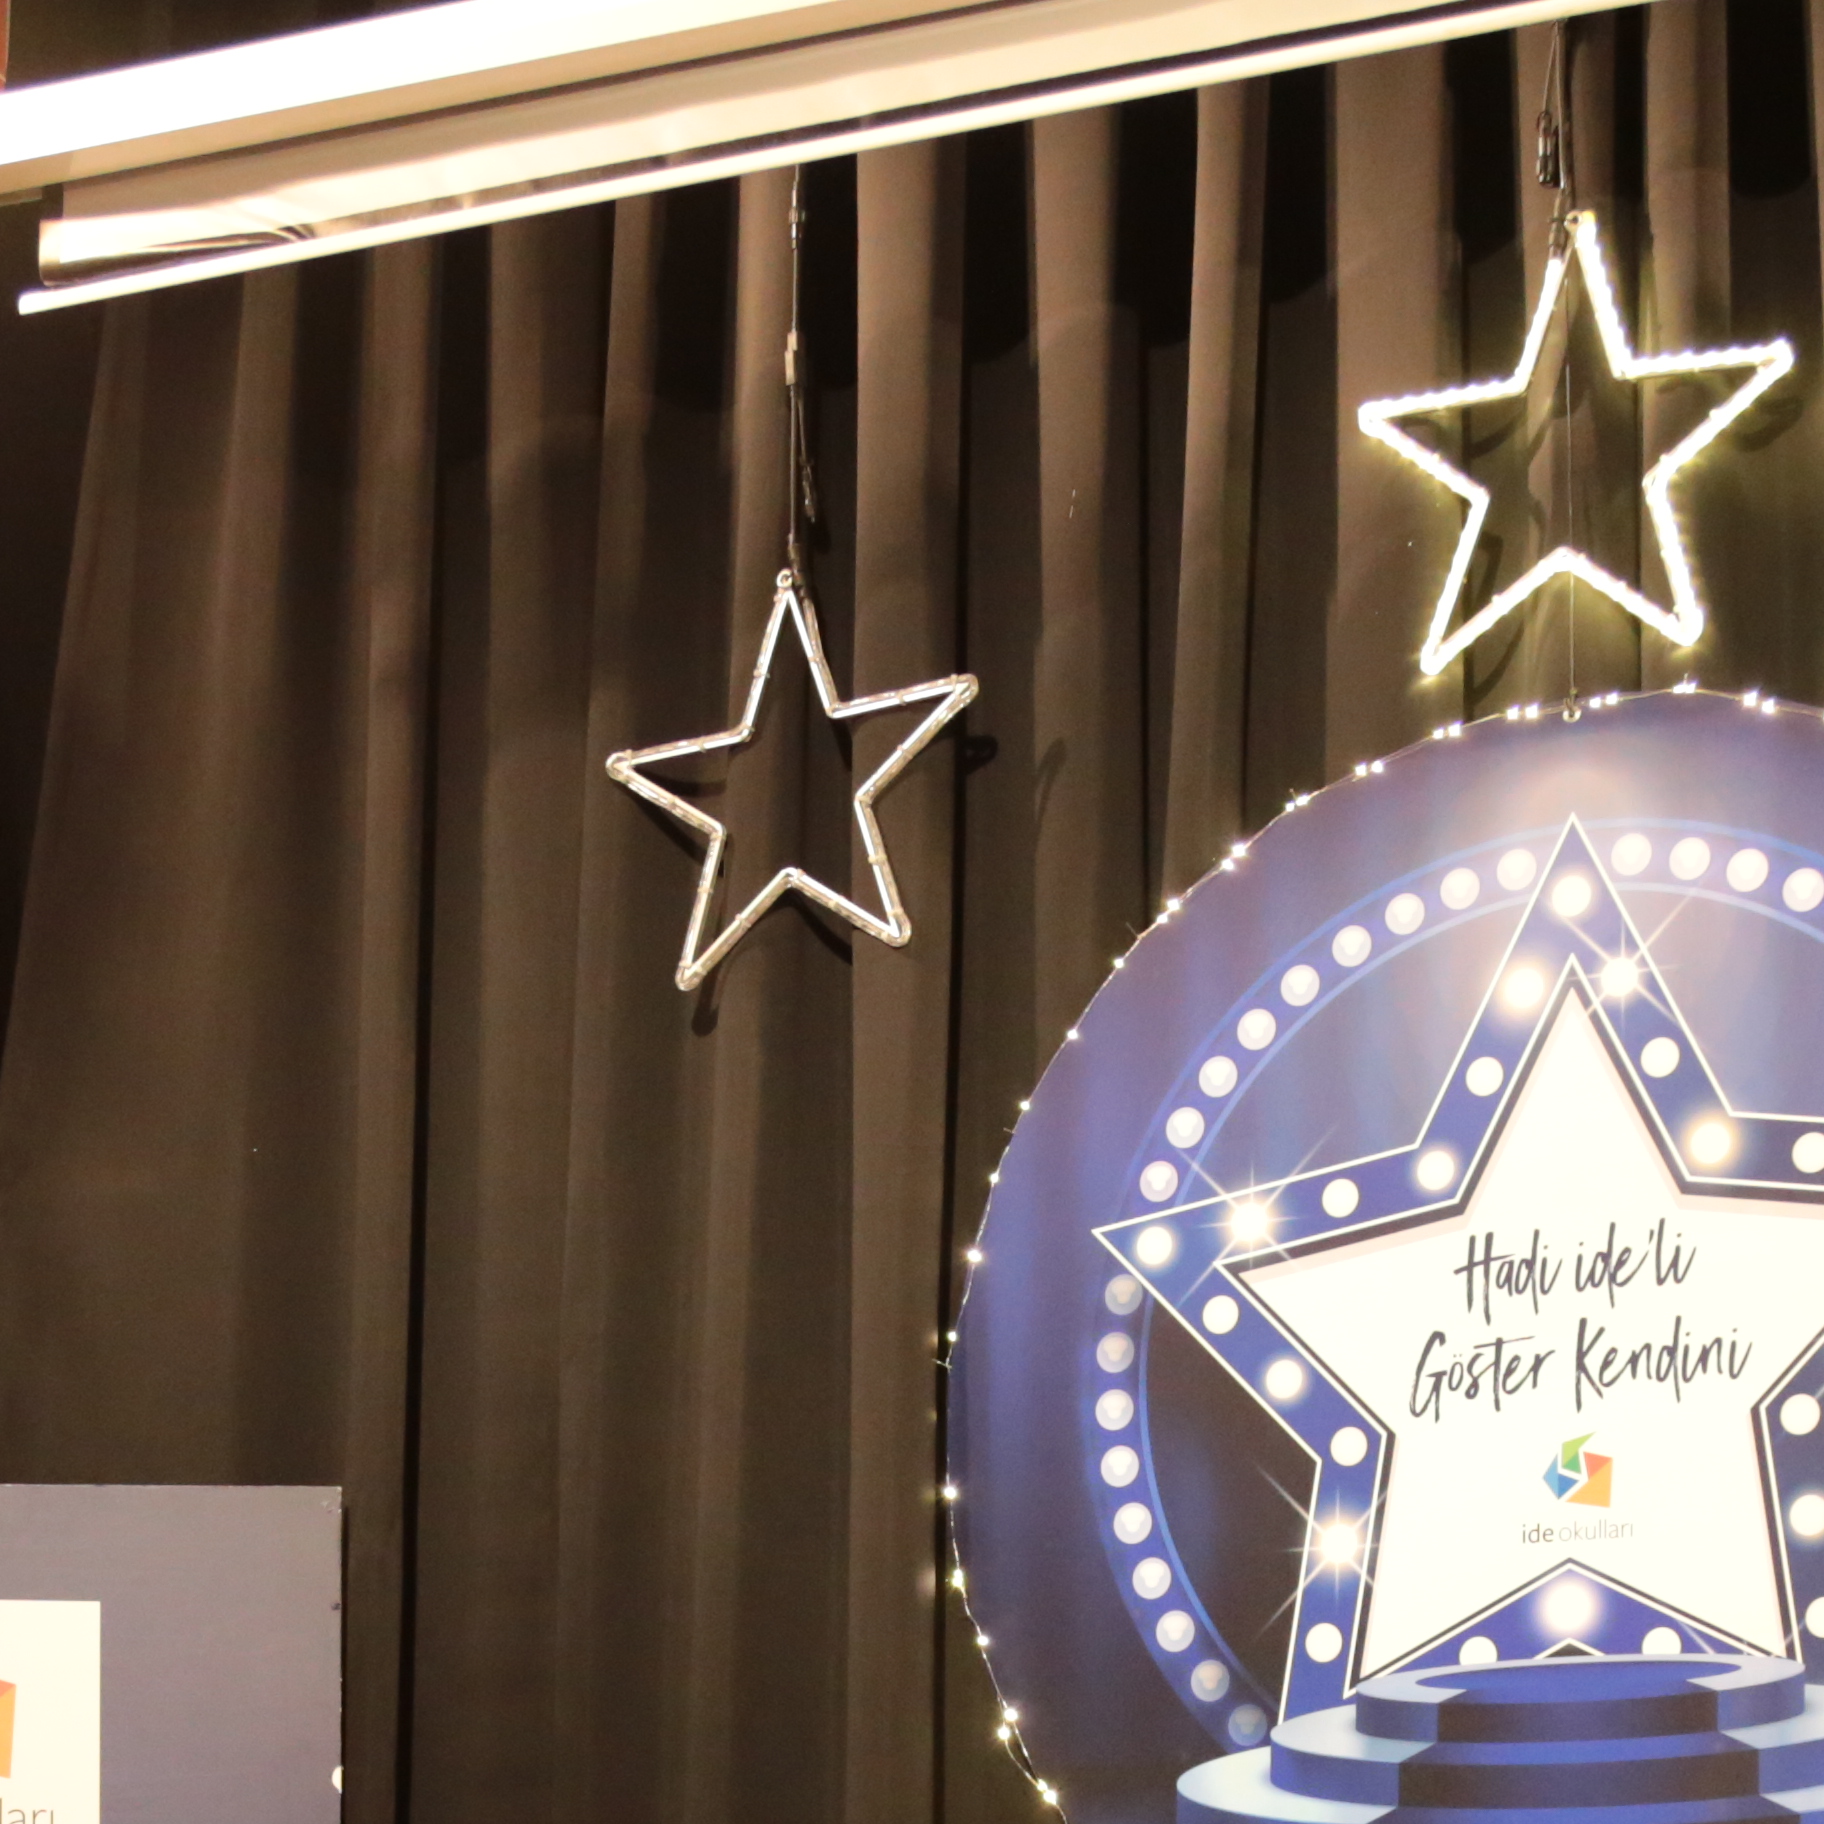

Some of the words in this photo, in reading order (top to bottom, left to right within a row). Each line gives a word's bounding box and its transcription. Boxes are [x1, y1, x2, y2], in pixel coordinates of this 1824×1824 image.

[1453, 1229, 1562, 1326] Hadi
[1408, 1330, 1556, 1423] Göster
[1574, 1315, 1753, 1413] Kendini
[1522, 1523, 1554, 1544] ide
[1558, 1519, 1634, 1542] okulları
